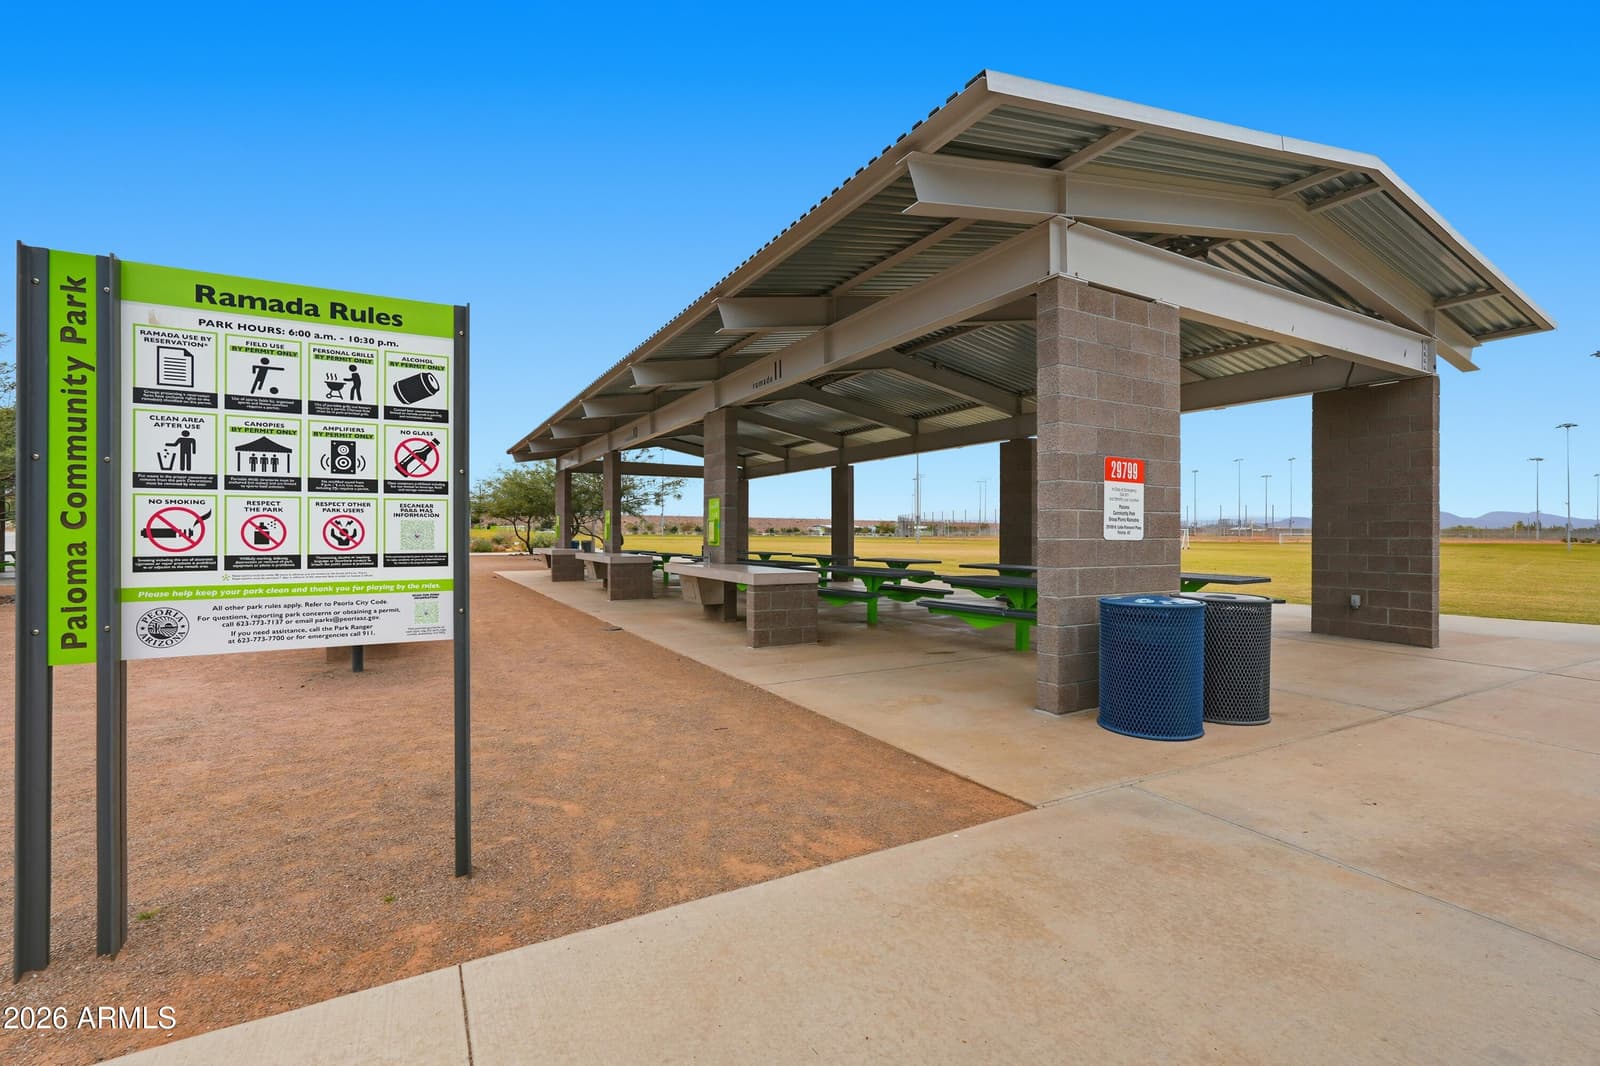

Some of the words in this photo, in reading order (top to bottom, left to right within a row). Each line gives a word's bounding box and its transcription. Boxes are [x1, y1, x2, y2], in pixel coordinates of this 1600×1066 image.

[59, 275, 87, 344] Park
[195, 284, 320, 317] Ramada
[330, 302, 403, 327] Rules
[140, 329, 180, 340] RAMADA
[181, 333, 199, 342] USE
[198, 318, 233, 330] PARK
[238, 322, 285, 335] HOURS:
[288, 329, 311, 338] 6:00
[313, 332, 337, 341] a.m.
[349, 336, 375, 345] 10:30
[377, 339, 400, 348] p.m.
[245, 340, 268, 349] FIELD
[245, 346, 275, 355] PERMIT
[276, 350, 298, 358] ONLY
[312, 347, 350, 357] PERSONAL
[351, 351, 375, 359] GRILLS
[326, 355, 353, 363] PERMIT
[401, 356, 434, 365] ALCOHOL
[401, 362, 426, 370] PERMIT
[149, 415, 179, 423] CLEAN
[244, 421, 285, 429] CANOPIES
[153, 422, 182, 430] AFTER
[244, 427, 275, 435] PERMIT
[322, 425, 365, 433] AMPLIFIERS
[60, 356, 95, 530] Community
[1111, 460, 1138, 480] 29799
[60, 541, 87, 650] Paloma
[138, 590, 170, 598] Please
[172, 589, 193, 599] help
[195, 588, 218, 598] keep
[220, 588, 241, 597] your
[243, 587, 264, 596] park
[265, 586, 289, 594] clean
[291, 585, 308, 593] and
[310, 585, 334, 593] thank
[335, 585, 350, 593] you
[352, 584, 364, 593] for
[366, 583, 396, 592] playing
[396, 583, 406, 591] by
[421, 582, 441, 590] rules.
[246, 604, 263, 612] park
[283, 602, 303, 611] apply.
[355, 599, 369, 607] City
[141, 608, 183, 624] PEORIA
[212, 614, 249, 622] questions,
[250, 612, 284, 621] reporting
[285, 611, 301, 620] park
[342, 608, 372, 616] obtaining
[235, 619, 284, 627] 623-773-7137
[350, 624, 373, 632] Ranger
[139, 630, 186, 647] ARIZONA
[237, 635, 285, 643] 623-773-7700
[307, 632, 349, 640] emergencies
